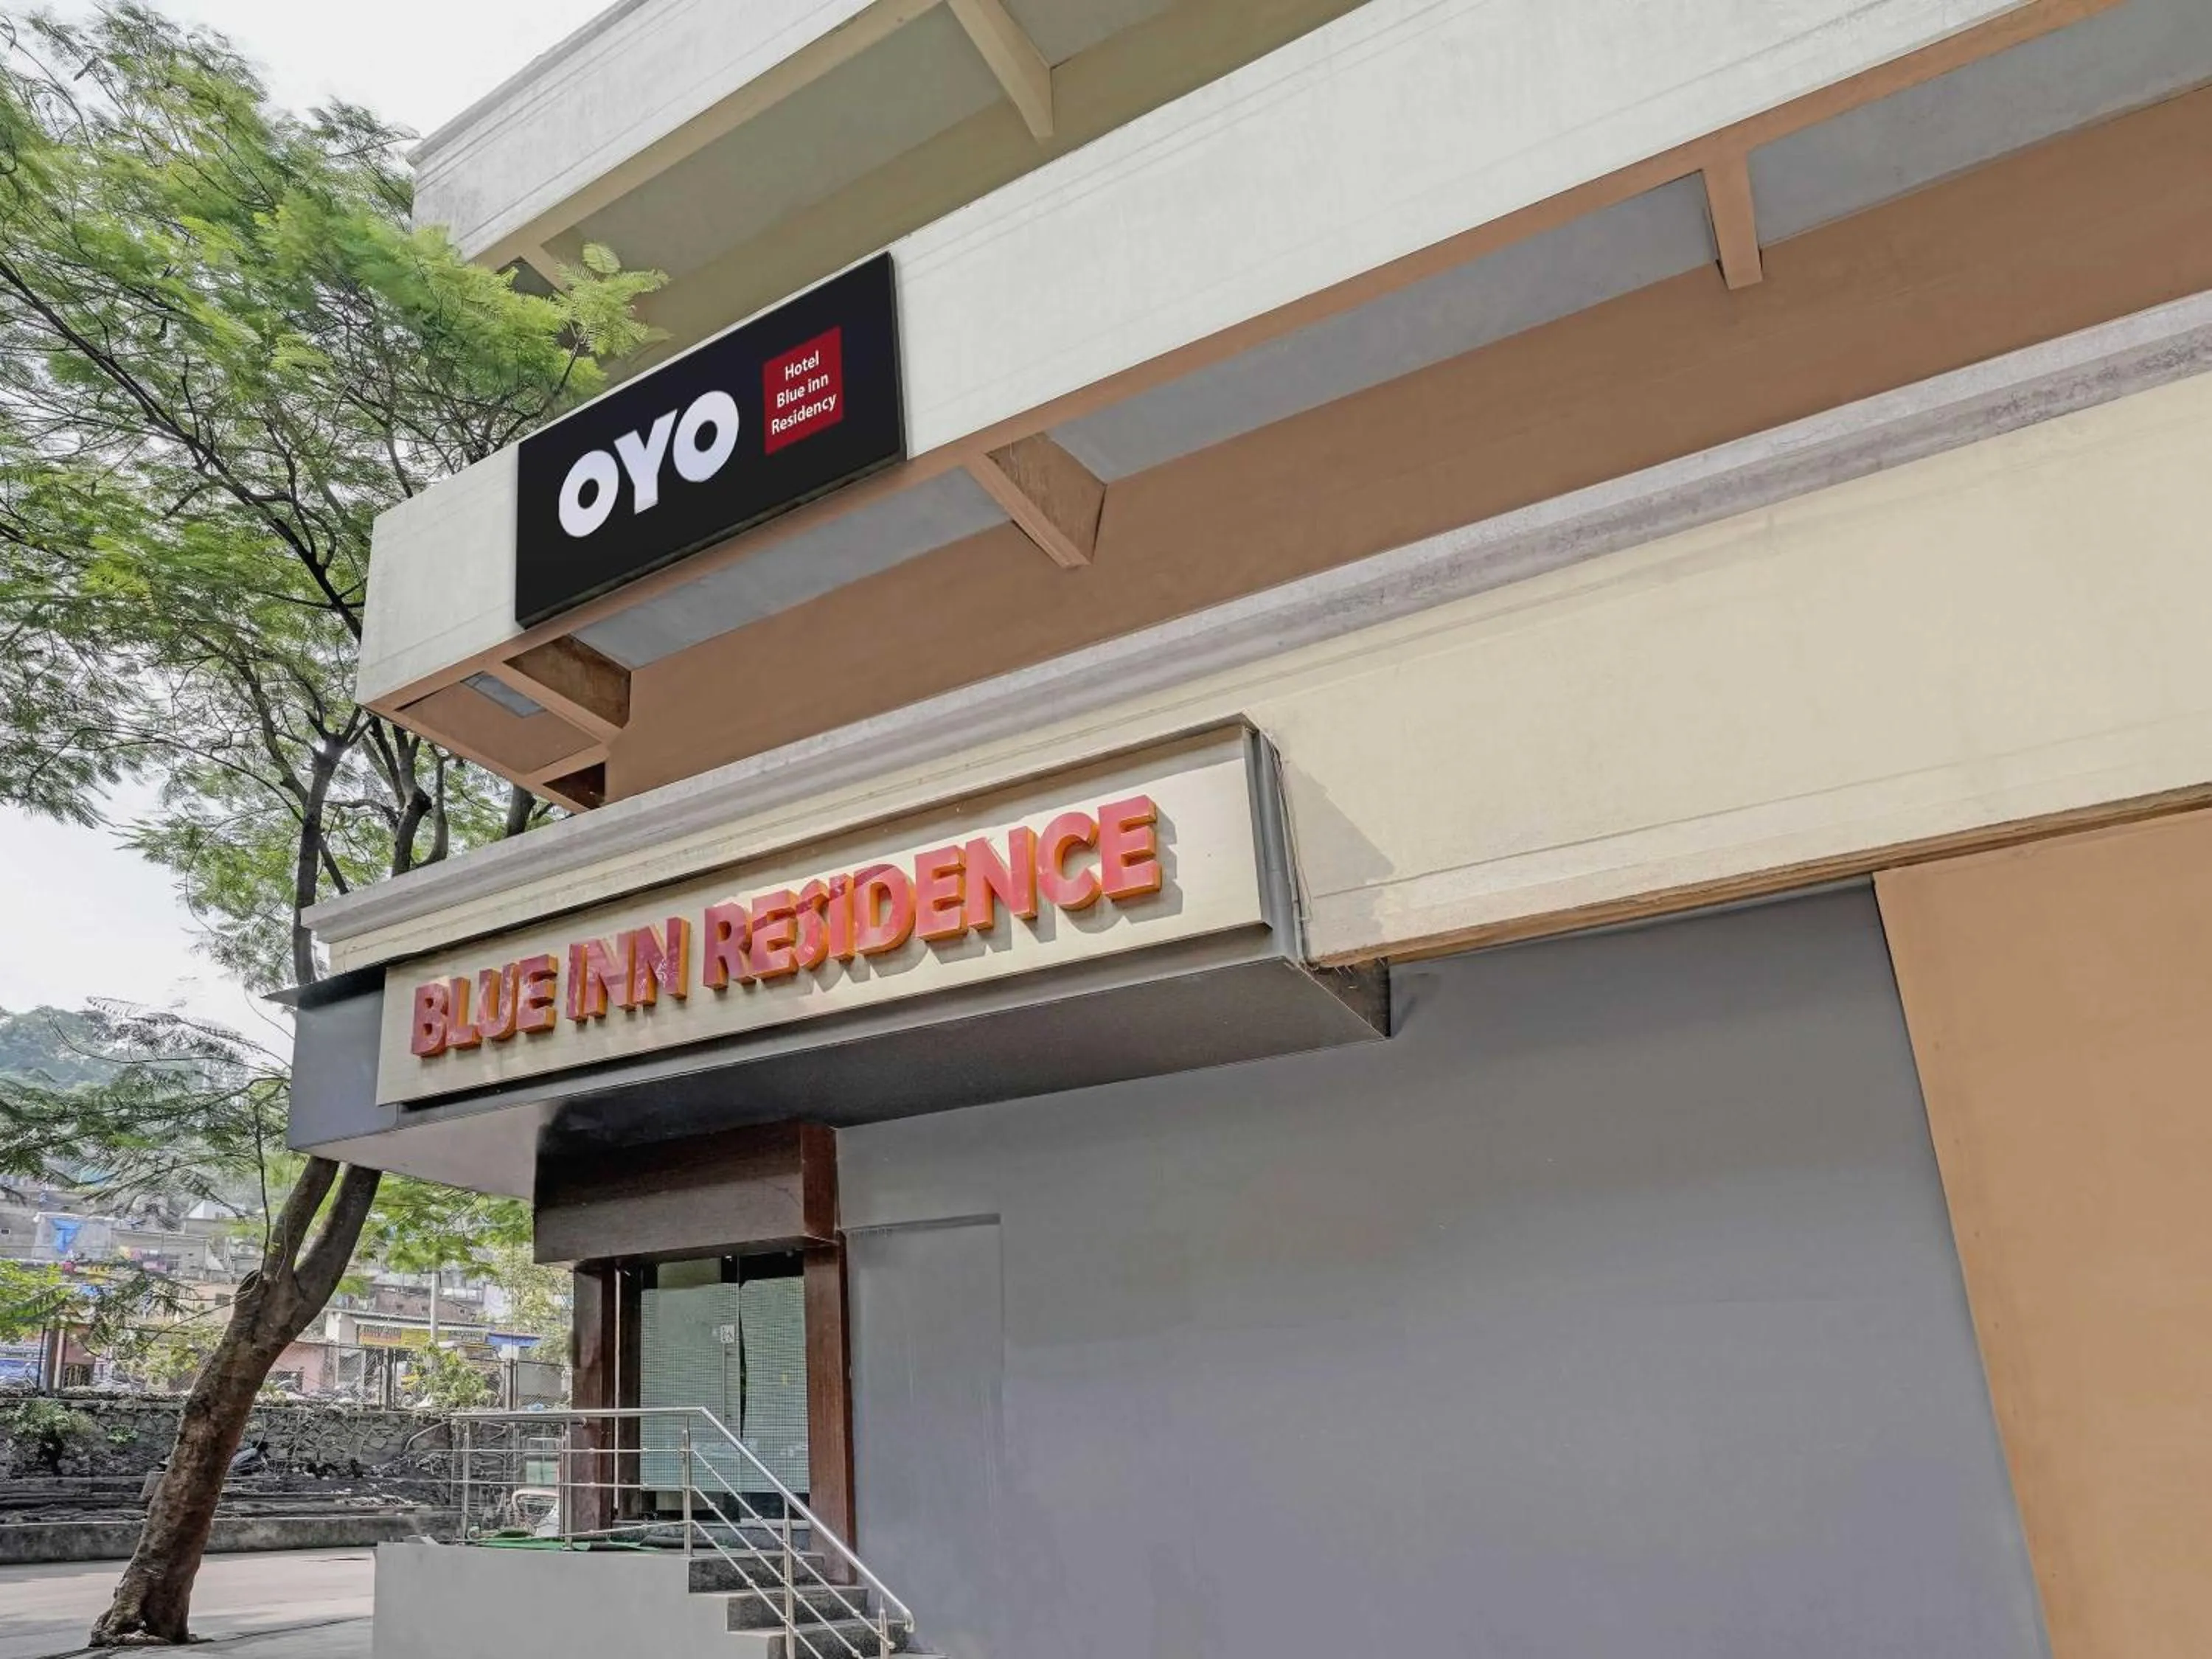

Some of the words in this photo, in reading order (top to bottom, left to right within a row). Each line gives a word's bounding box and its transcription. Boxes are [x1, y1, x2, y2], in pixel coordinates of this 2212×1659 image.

[785, 349, 820, 381] Hotel
[776, 385, 804, 408] Blue
[807, 374, 830, 393] inn
[771, 393, 838, 435] Residency
[558, 390, 739, 538] OYO
[410, 953, 559, 1057] BLUE
[566, 916, 691, 1023] INN
[703, 794, 1162, 990] RESIDENCE
